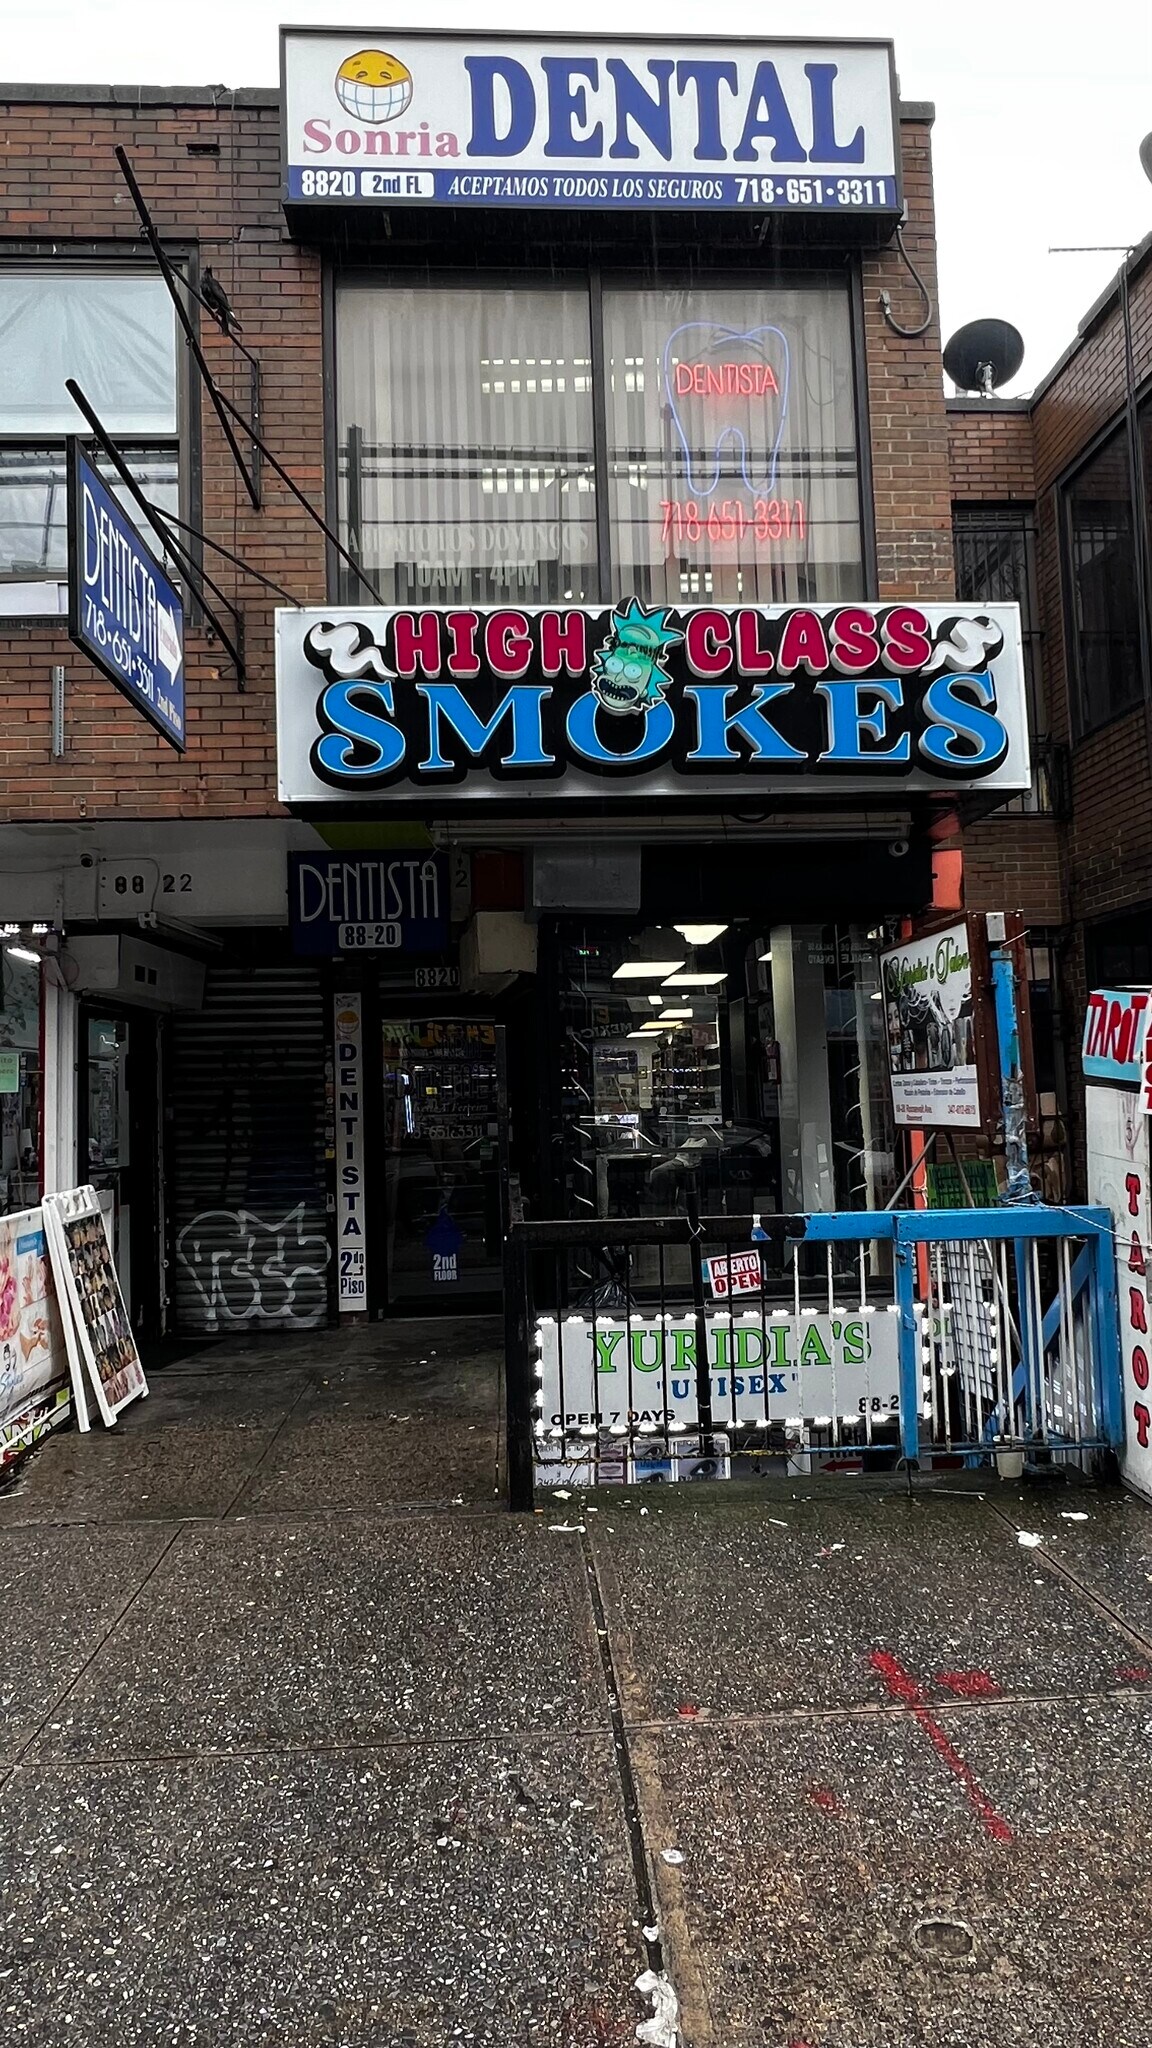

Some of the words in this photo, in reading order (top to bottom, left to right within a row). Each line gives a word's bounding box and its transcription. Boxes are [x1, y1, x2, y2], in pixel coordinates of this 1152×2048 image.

[464, 55, 864, 163] DENTAL
[302, 118, 460, 158] Sonria
[301, 170, 355, 197] 8820
[371, 173, 400, 195] 2nd
[405, 174, 423, 195] FL
[448, 175, 549, 198] ACEPTAMOS
[552, 177, 605, 198] TODOS
[608, 178, 644, 199] LOS
[646, 179, 724, 201] SEGUROS
[675, 363, 780, 395] DENTISTA
[81, 481, 159, 667] DENTISTA
[403, 559, 470, 588] 10AM
[490, 559, 540, 587] 4PM
[391, 607, 590, 677] HIGH
[685, 604, 934, 677] CLASS
[315, 671, 1010, 779] SMOKES
[114, 875, 144, 895] 88
[162, 873, 193, 894] 22
[299, 861, 440, 924] DENTISTA
[344, 925, 396, 947] 88-20
[415, 968, 460, 987] 8820
[1085, 993, 1150, 1066] TAROT
[338, 1043, 363, 1237] DENTISTA
[432, 1252, 457, 1270] 2nd
[433, 1269, 458, 1281] FLOOR
[713, 1254, 758, 1278] ABERTO
[340, 1277, 366, 1296] Piso
[714, 1271, 762, 1293] OPEN
[1124, 1171, 1152, 1450] TAROT
[586, 1320, 873, 1374] YURIDIA'S
[550, 1411, 603, 1426] OPEN
[609, 1411, 621, 1424] 7
[627, 1409, 676, 1424] DAYS
